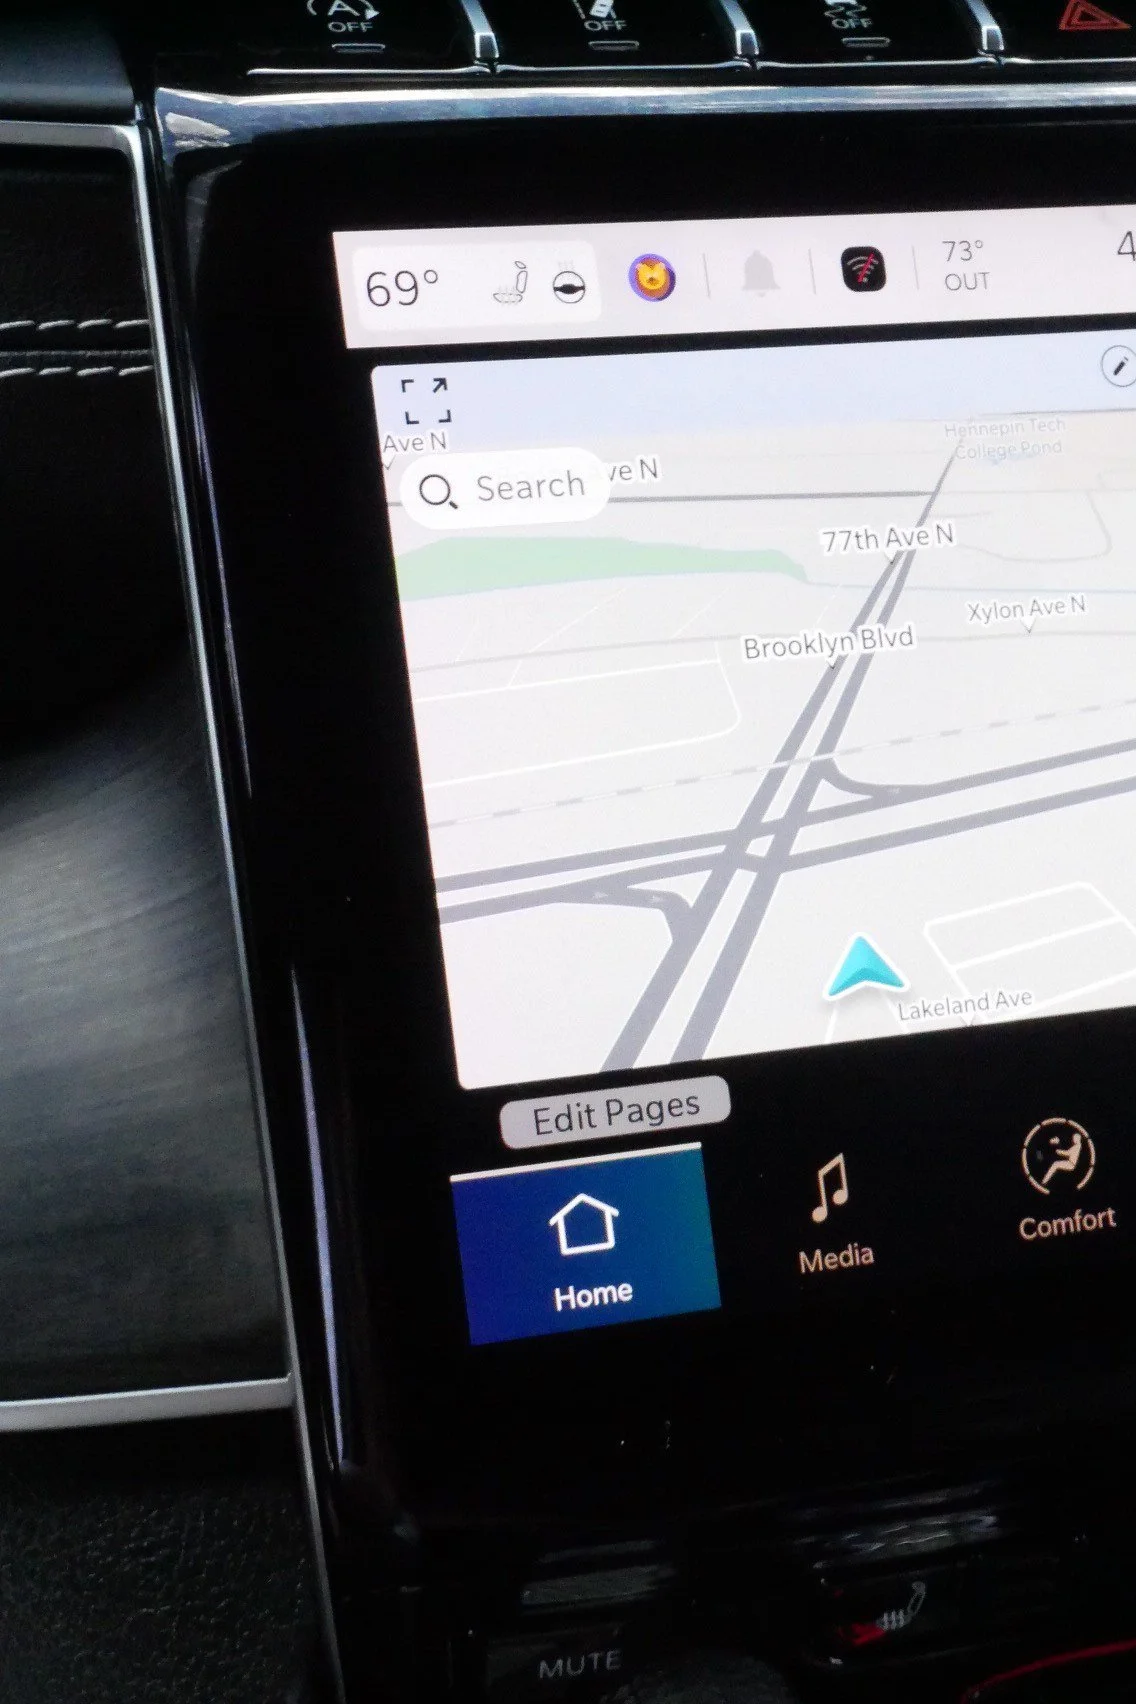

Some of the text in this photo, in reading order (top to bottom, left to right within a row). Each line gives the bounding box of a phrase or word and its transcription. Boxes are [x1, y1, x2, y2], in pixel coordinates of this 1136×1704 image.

[327, 21, 373, 33] OFF
[585, 17, 626, 31] OFF
[832, 15, 874, 30] OFF
[942, 239, 984, 263] 73°
[365, 267, 438, 308] 69°
[945, 271, 989, 292] OUT
[1030, 417, 1066, 433] Tech
[383, 431, 447, 453] Ave N
[955, 440, 1061, 461] College Pond
[640, 457, 659, 480] N
[477, 469, 585, 502] Search
[823, 523, 954, 555] 77th Ave N
[967, 594, 1087, 625] Xylon Ave N
[744, 625, 914, 662] Brooklyn Blvd
[898, 989, 1032, 1023] Lakeland Ave
[533, 1092, 702, 1137] Edit Pages
[1018, 1207, 1118, 1242] Comfort
[798, 1242, 875, 1275] Media
[554, 1280, 634, 1312] Home
[538, 1648, 624, 1680] MUTE
